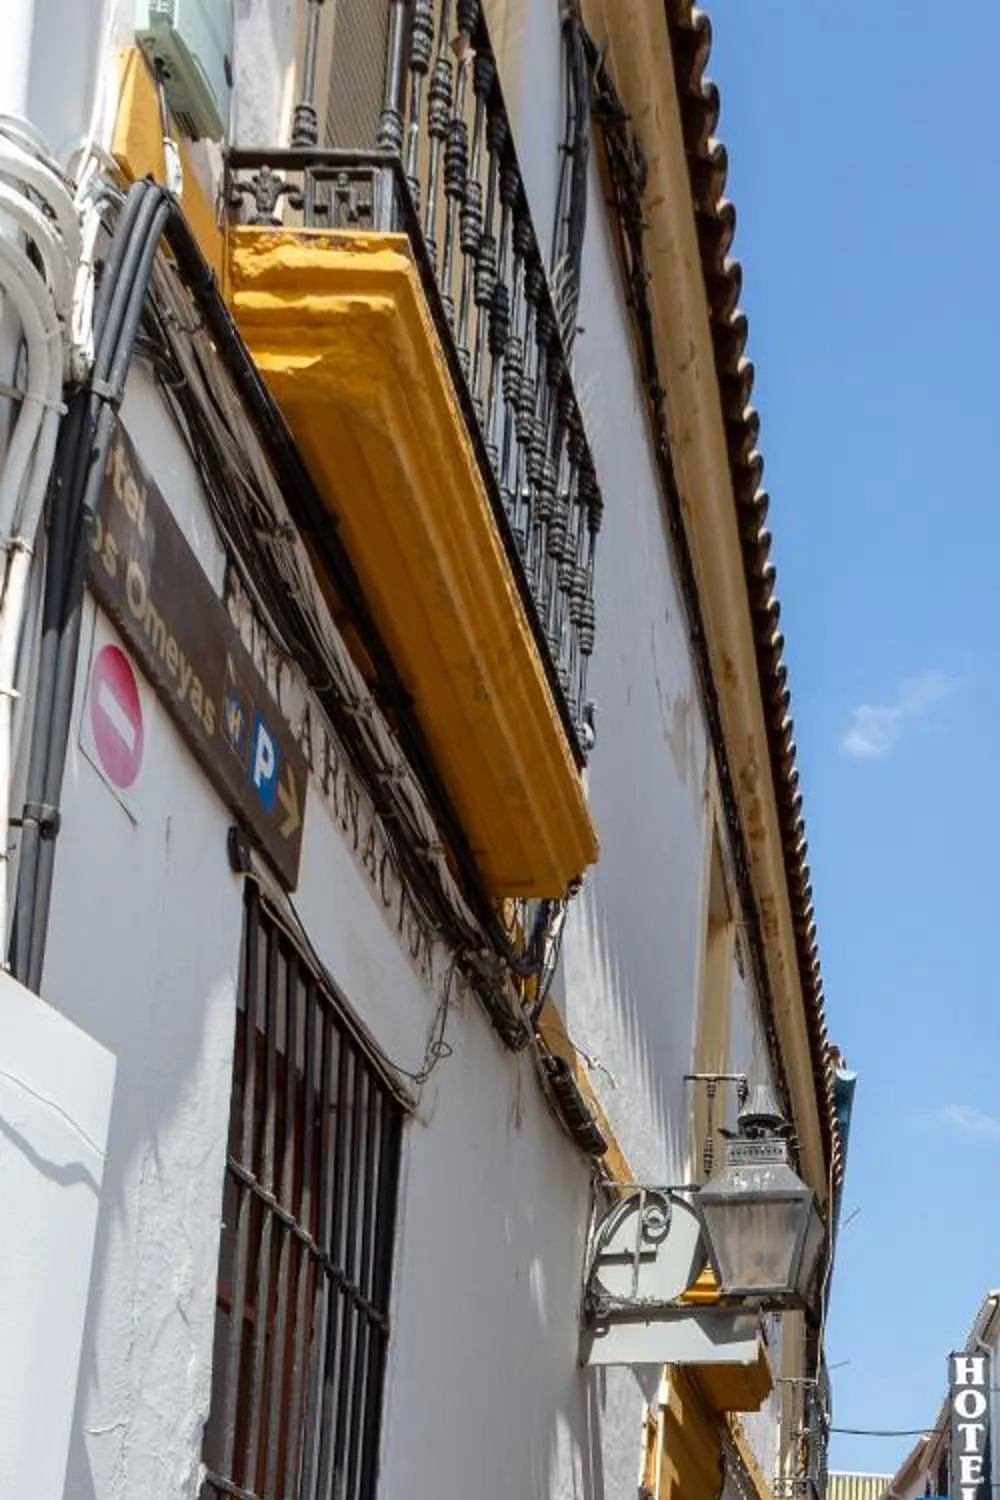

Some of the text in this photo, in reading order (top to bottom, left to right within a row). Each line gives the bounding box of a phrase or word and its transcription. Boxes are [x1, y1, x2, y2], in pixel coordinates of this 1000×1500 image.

[106, 443, 148, 541] tel
[126, 560, 217, 736] Omeyas
[254, 722, 275, 789] P
